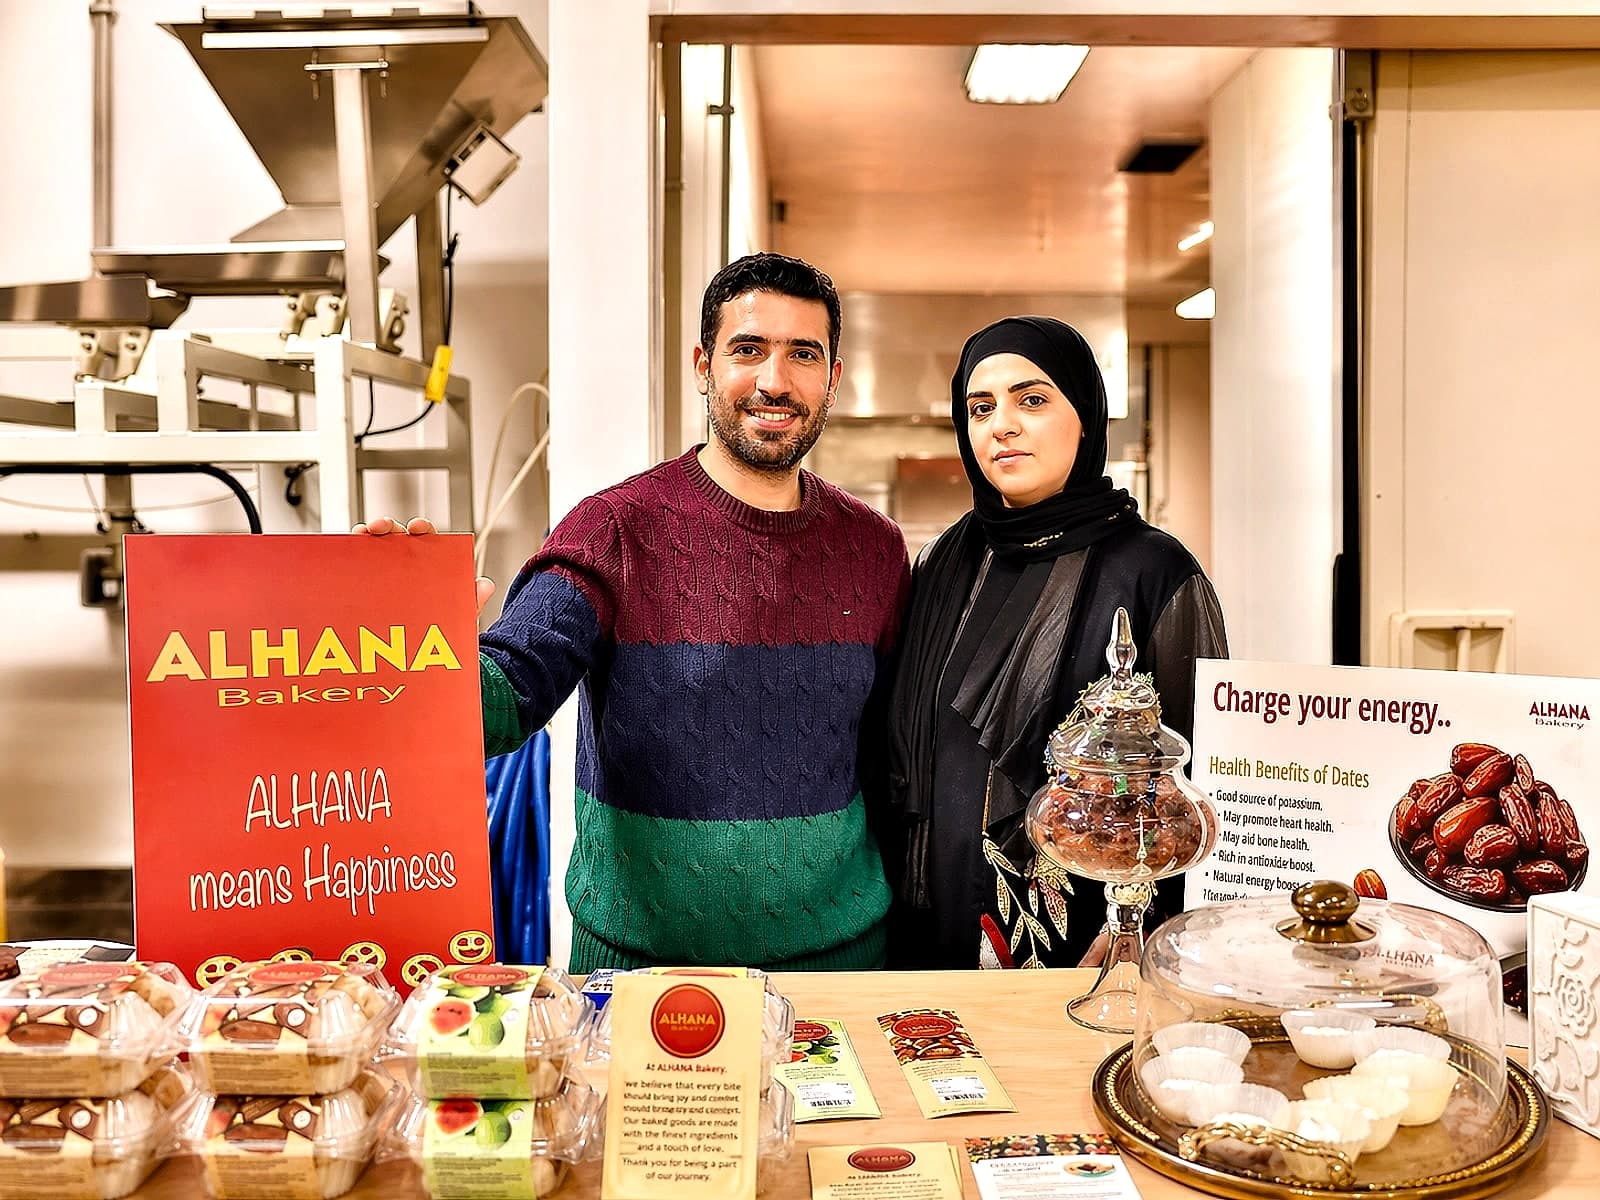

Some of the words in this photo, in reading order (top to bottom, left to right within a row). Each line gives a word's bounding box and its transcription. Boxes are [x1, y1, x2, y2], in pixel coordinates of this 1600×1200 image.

[146, 624, 462, 682] ALHANA
[217, 684, 406, 707] Bakery
[1213, 681, 1291, 724] Charge
[1298, 693, 1351, 726] your
[1358, 697, 1451, 735] energy..
[1529, 701, 1591, 720] ALHANA
[1535, 717, 1585, 730] Bakery
[1209, 755, 1251, 777] Health
[1256, 760, 1309, 783] Benefits
[1313, 764, 1328, 785] of
[1332, 766, 1370, 788] Dates
[245, 767, 391, 832] ALHANA
[1216, 789, 1238, 803] Good
[1239, 793, 1267, 805] source
[1267, 794, 1278, 806] of
[1278, 797, 1323, 811] potassium.
[1223, 810, 1241, 826] May
[1242, 814, 1278, 828] promote
[1279, 815, 1303, 829] heart
[1304, 818, 1334, 833] health.
[1222, 830, 1240, 846] May
[1241, 832, 1256, 846] aid
[1257, 834, 1279, 848] bone
[1279, 836, 1310, 851] health.
[1218, 849, 1236, 863] Rich
[1237, 851, 1246, 864] in
[1289, 858, 1316, 873] boost.
[189, 865, 293, 911] means
[303, 843, 457, 916] Happiness
[1213, 869, 1244, 884] Natural
[1245, 875, 1275, 891] energy
[659, 1012, 716, 1025] ALHANA
[640, 1080, 673, 1089] believe
[675, 1081, 694, 1090] that
[696, 1083, 721, 1091] every
[723, 1082, 742, 1091] bite
[623, 1092, 652, 1100] should
[653, 1093, 675, 1102] bring
[676, 1094, 689, 1103] joy
[691, 1094, 707, 1102] and
[623, 1117, 639, 1125] Our
[641, 1117, 669, 1126] baked
[670, 1118, 697, 1127] goods
[713, 1118, 738, 1127] made
[623, 1130, 642, 1138] with
[645, 1130, 660, 1138] the
[662, 1131, 687, 1139] finest
[689, 1132, 739, 1141] ingredients
[636, 1143, 654, 1151] and
[663, 1144, 689, 1152] touch
[691, 1144, 702, 1152] of
[622, 1158, 648, 1166] Thank
[650, 1159, 666, 1168] you
[669, 1158, 682, 1167] for
[684, 1159, 709, 1169] being
[718, 1160, 737, 1168] part
[645, 1171, 656, 1179] of
